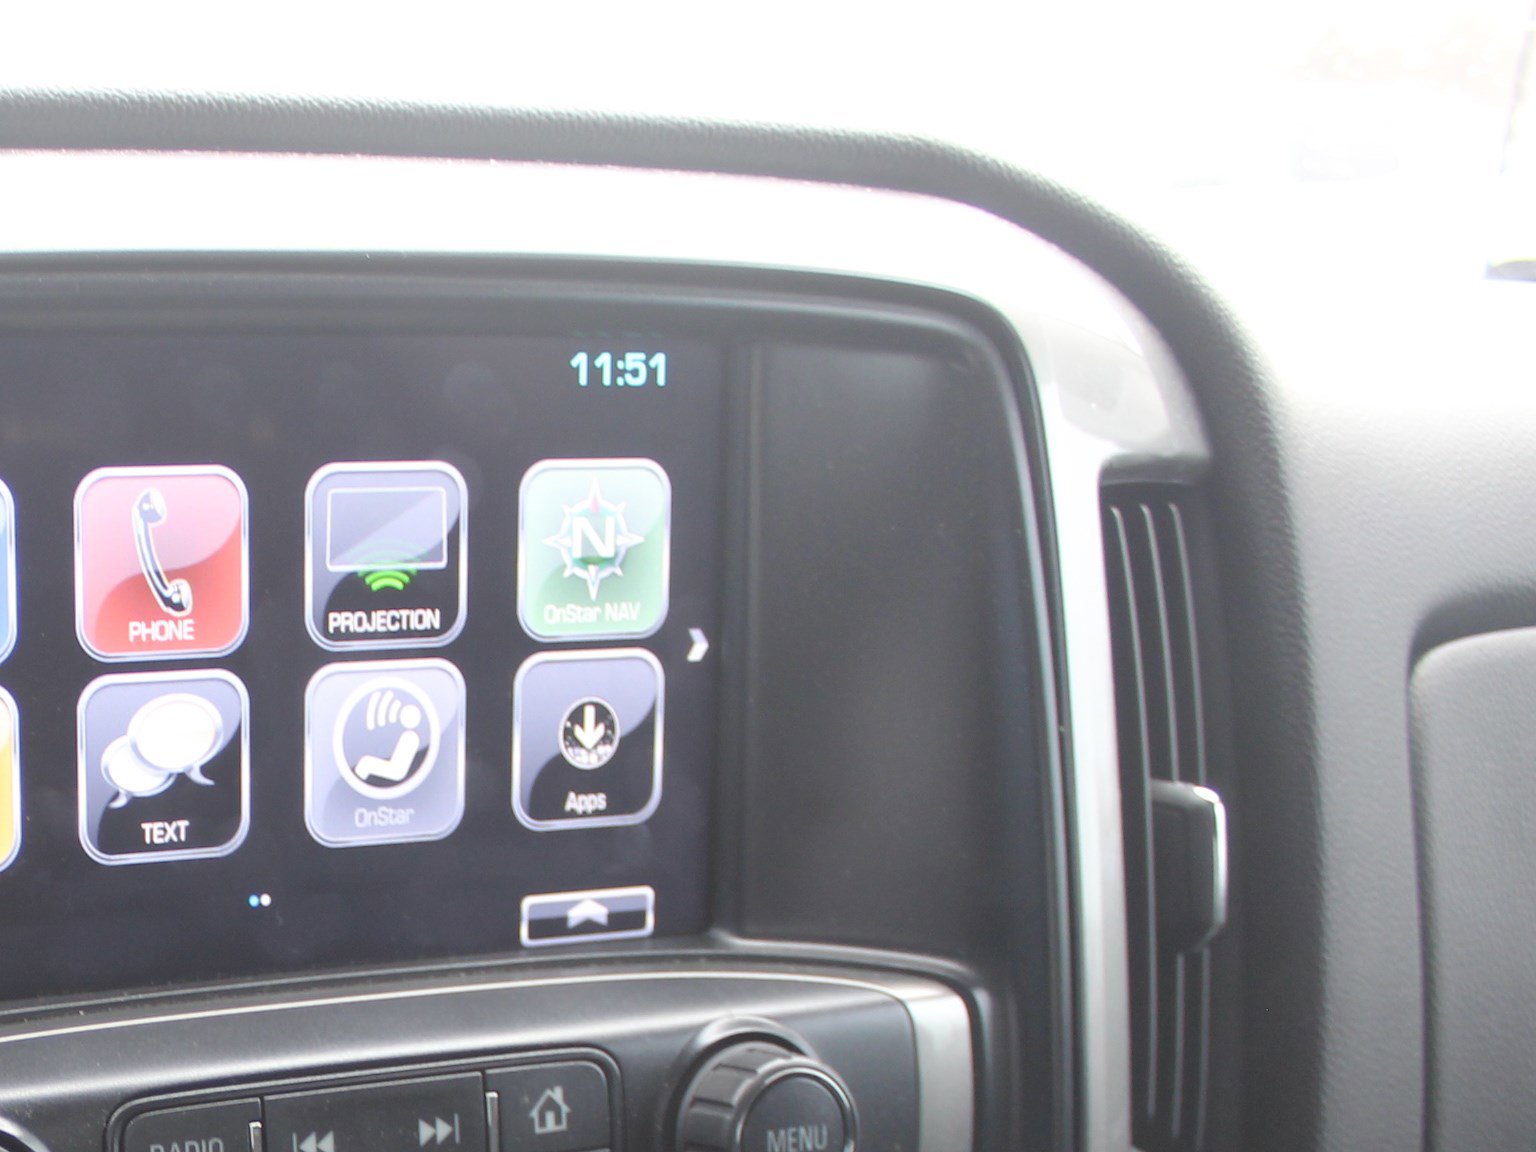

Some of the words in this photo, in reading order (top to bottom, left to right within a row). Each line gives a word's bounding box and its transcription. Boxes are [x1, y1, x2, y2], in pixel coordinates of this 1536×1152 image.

[570, 351, 667, 387] 11:51
[328, 608, 441, 634] PROJECTION
[544, 603, 602, 625] OnStar
[605, 602, 640, 621] NAV
[128, 619, 195, 643] PHONE
[565, 791, 607, 813] Apps
[354, 805, 415, 828] OnStar
[141, 820, 190, 844] TEXT
